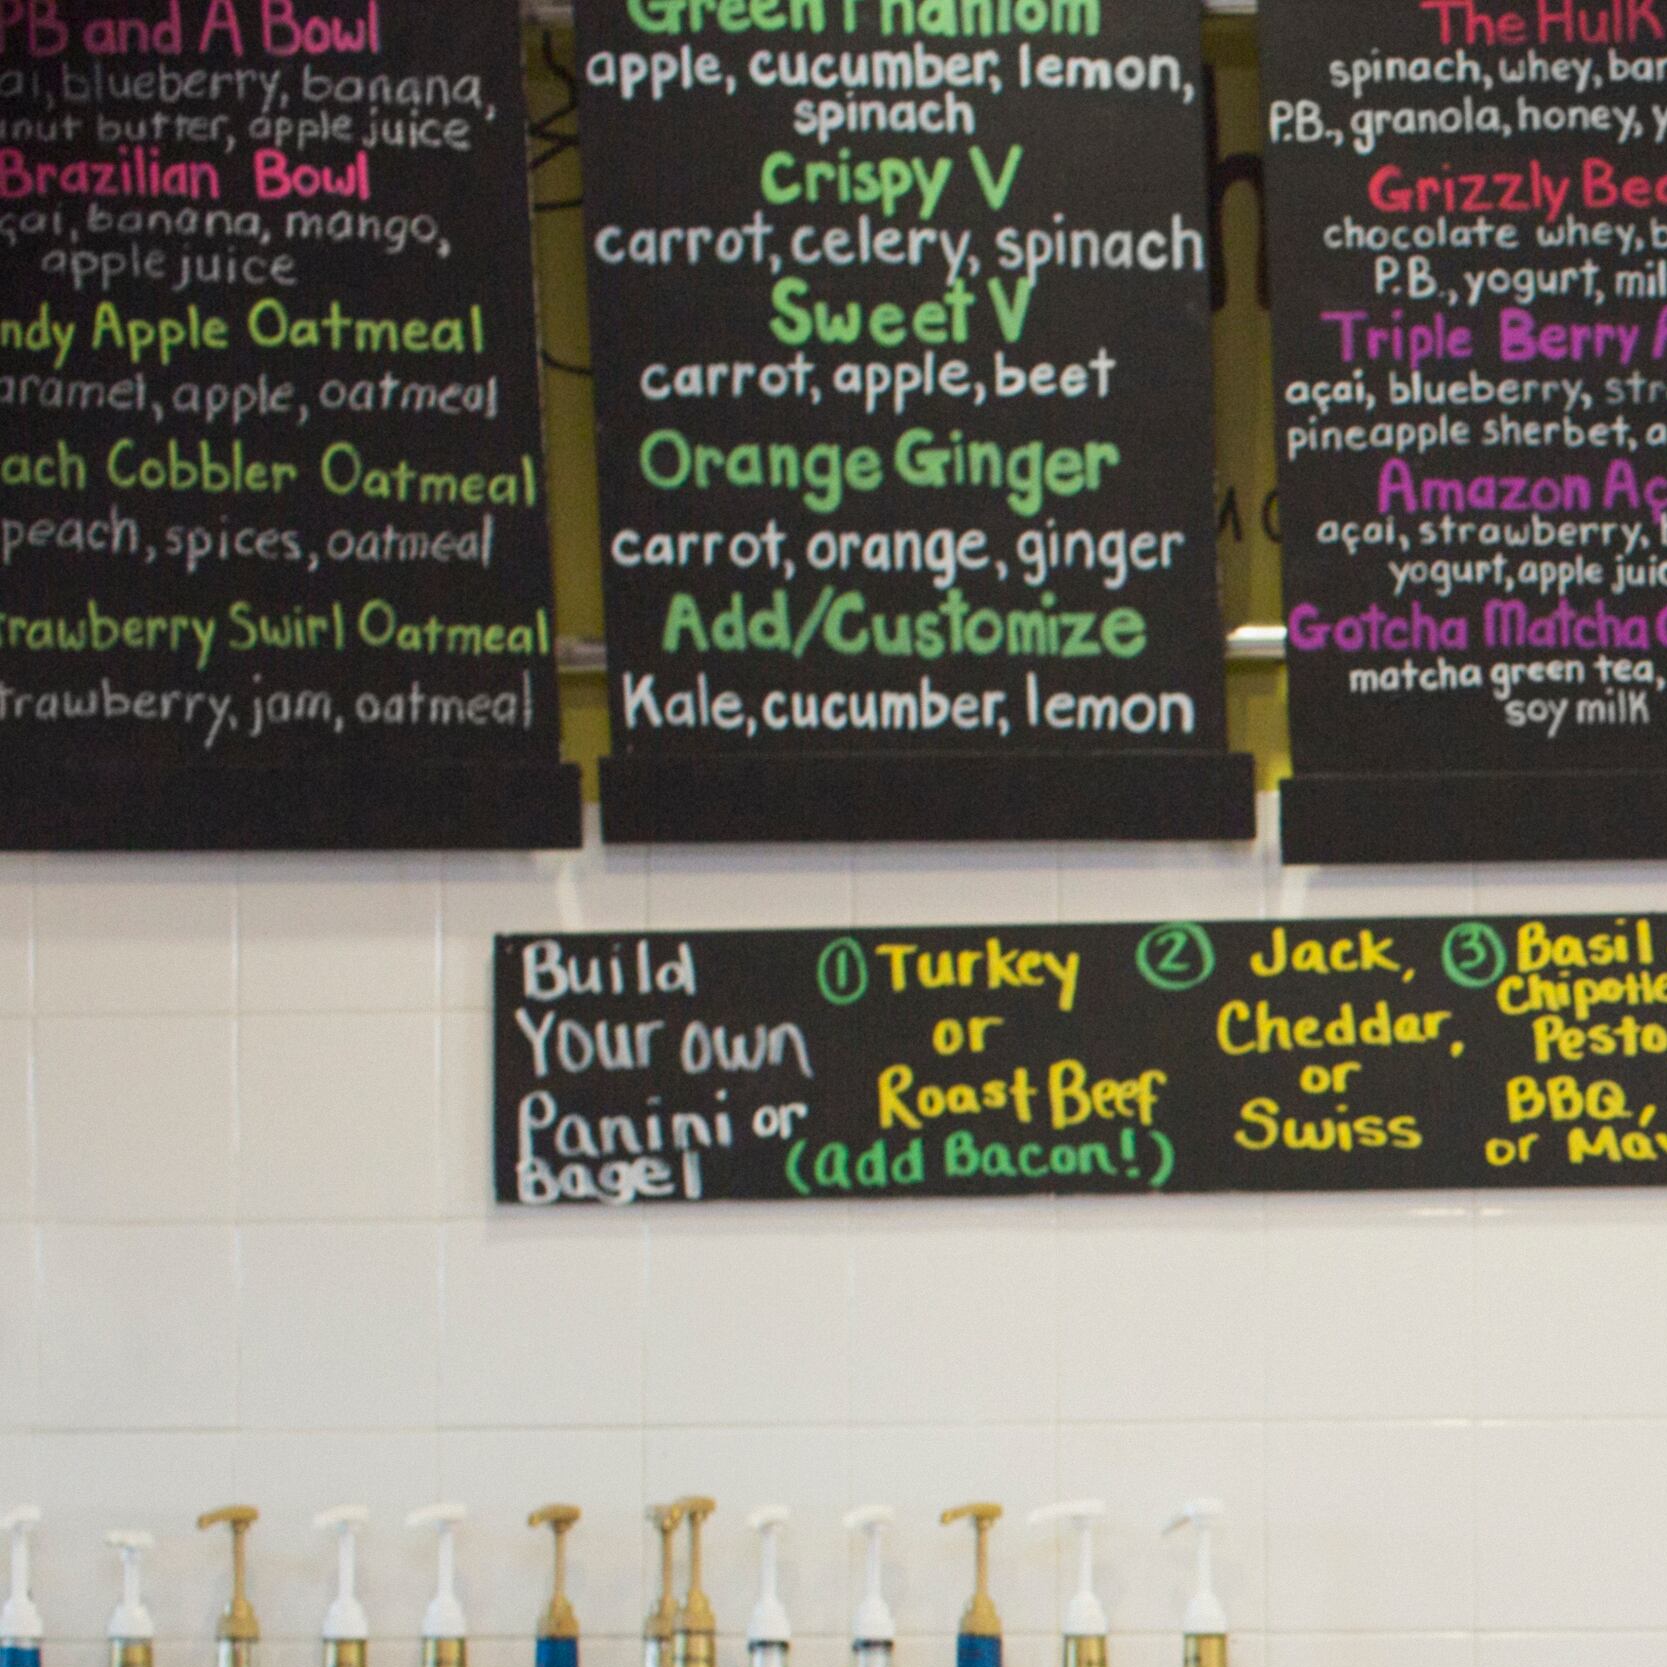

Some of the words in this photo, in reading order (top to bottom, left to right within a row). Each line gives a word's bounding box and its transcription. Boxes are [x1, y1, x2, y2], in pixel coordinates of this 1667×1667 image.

[261, 2, 379, 56] Bowl
[793, 90, 976, 145] spinach
[253, 148, 370, 201] Bowl
[760, 147, 953, 220] Crispy
[968, 144, 1023, 210] V
[1367, 159, 1570, 225] Grizzly
[995, 212, 1205, 287] spinach
[92, 300, 229, 366] Apple
[247, 297, 484, 353] Oatmeal
[770, 274, 976, 347] Sweet
[987, 275, 1034, 343] V
[1319, 308, 1473, 372] Triple
[1499, 306, 1640, 365] Berry
[1286, 413, 1470, 461] pineapple
[106, 437, 298, 493] Cobbler
[320, 441, 537, 507] Oatmeal
[640, 429, 884, 514] Orange
[894, 427, 1121, 517] Ginger
[1377, 456, 1591, 514] Amazon
[229, 600, 345, 650] Swirl
[357, 598, 550, 656] Oatmeal
[663, 584, 1147, 660] Add/Customize
[1286, 600, 1468, 652] Gotcha
[1348, 656, 1483, 693] matcha
[1489, 659, 1586, 701] green
[521, 939, 697, 1001] Build
[875, 937, 1080, 1012] Turkey
[1517, 918, 1653, 976] Basil
[514, 1007, 664, 1077] Your
[680, 1020, 813, 1077] own
[932, 1016, 1003, 1055] or
[877, 1064, 1037, 1129] Roast
[1048, 1058, 1167, 1130] Beef
[1234, 1097, 1423, 1152] Swiss
[514, 1148, 704, 1206] Bagel
